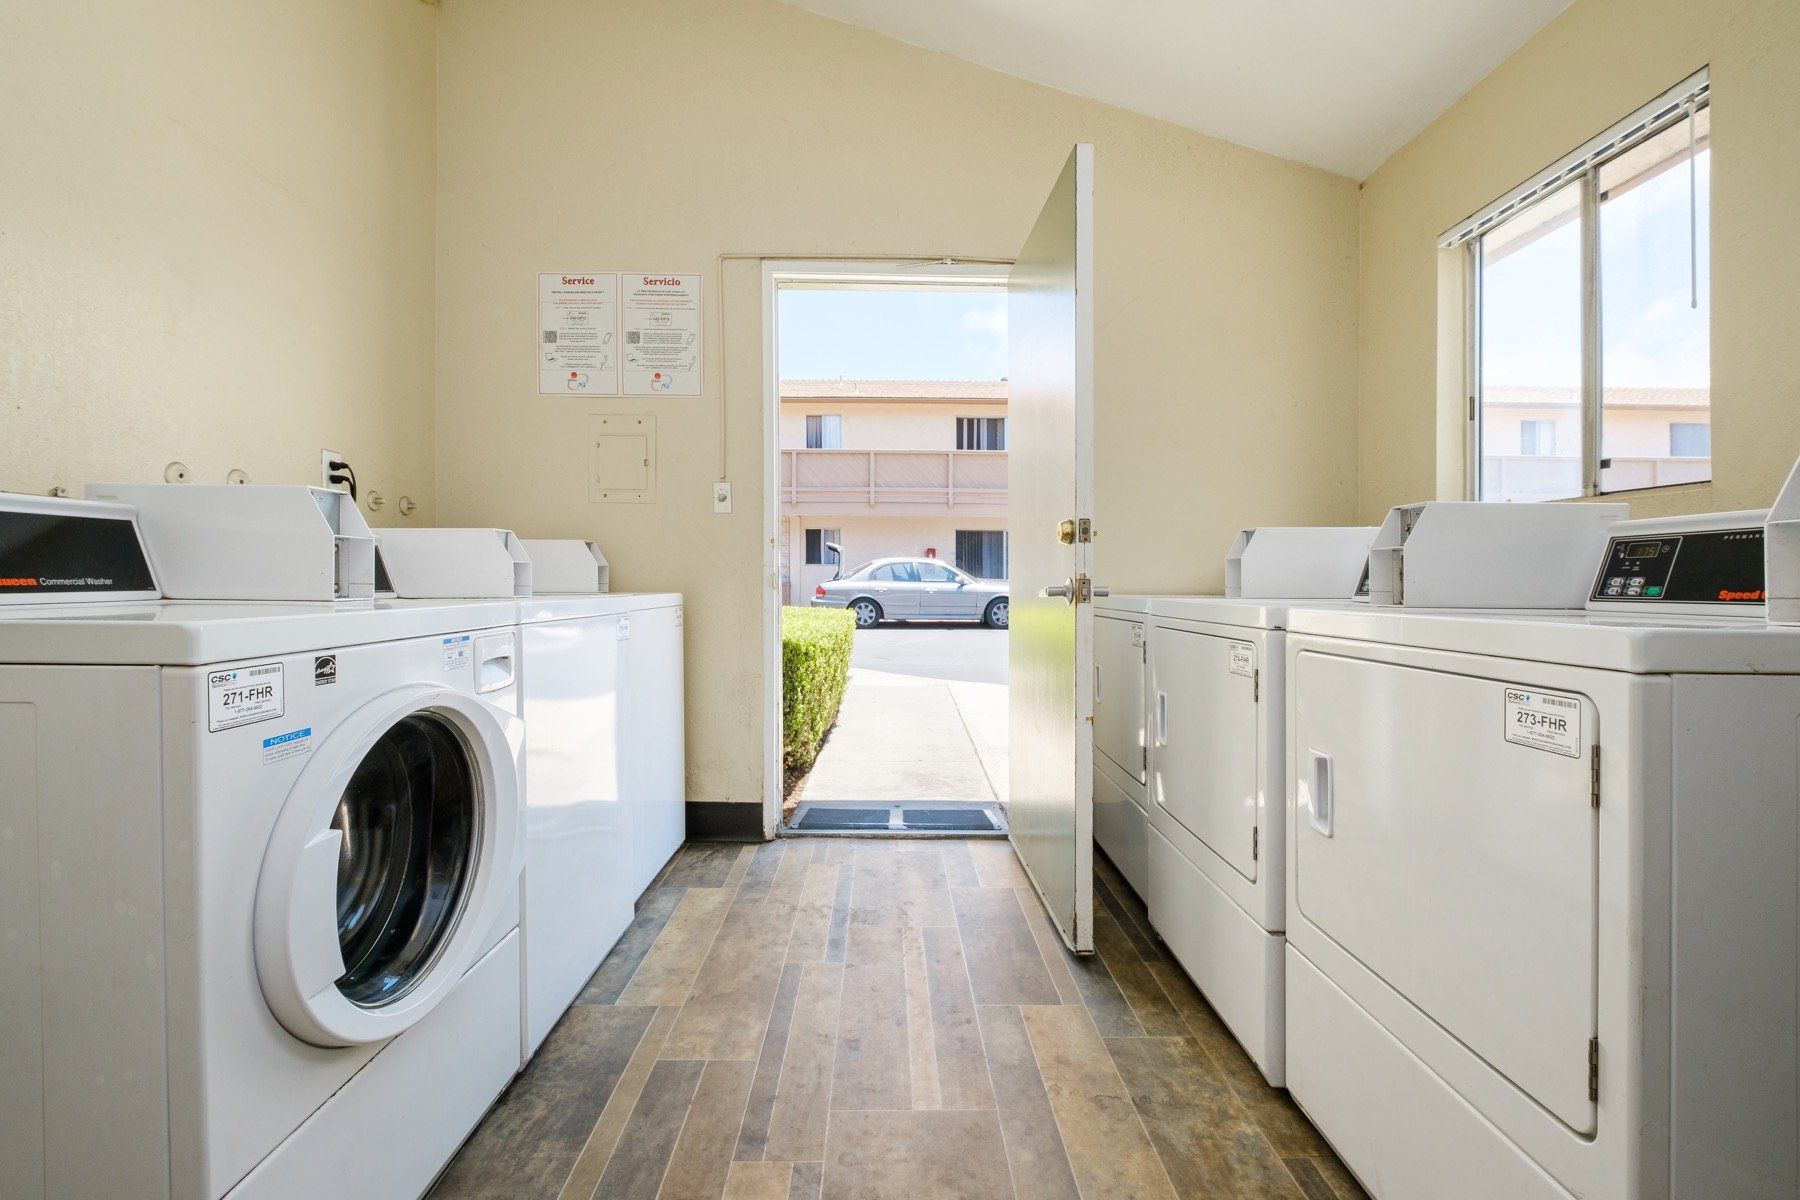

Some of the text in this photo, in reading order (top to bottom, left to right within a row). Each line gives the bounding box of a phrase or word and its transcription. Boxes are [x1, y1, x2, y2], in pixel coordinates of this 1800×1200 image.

[562, 276, 595, 285] Service
[643, 277, 681, 286] Servicio
[0, 577, 113, 586] ueen Commercial Washer
[1719, 590, 1760, 601] Speed
[211, 674, 231, 684] CSC
[223, 686, 273, 706] 271-FHR
[1507, 692, 1525, 701] CSC
[1517, 711, 1567, 732] 273-FHR
[270, 731, 304, 745] NOTICE
